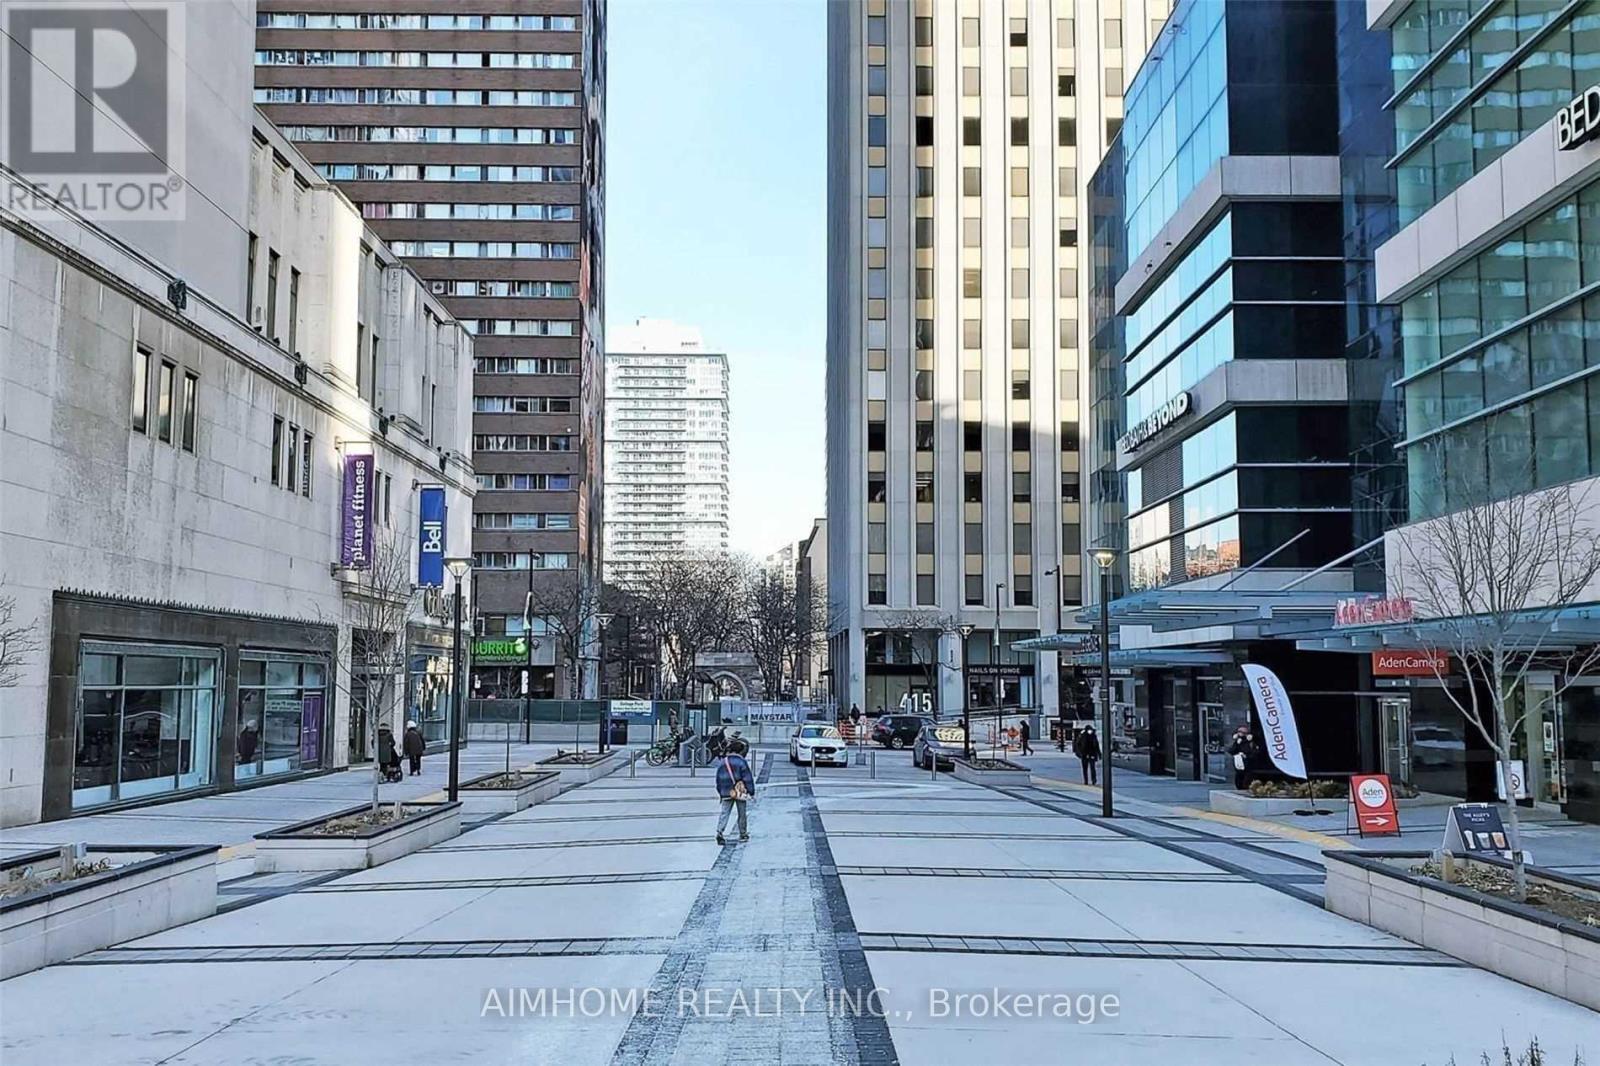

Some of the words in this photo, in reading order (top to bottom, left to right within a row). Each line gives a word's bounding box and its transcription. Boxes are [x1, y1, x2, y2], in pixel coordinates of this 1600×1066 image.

[1557, 85, 1600, 150] BED
[1147, 391, 1189, 435] BEYOND
[352, 460, 365, 511] fitness
[351, 514, 365, 561] planet
[423, 521, 441, 553] Bell
[1378, 656, 1445, 669] AdenCamera
[751, 713, 793, 721] MAYSTAR
[899, 693, 932, 713] 415
[1256, 676, 1289, 761] AdenCamera
[1362, 788, 1385, 796] Aden
